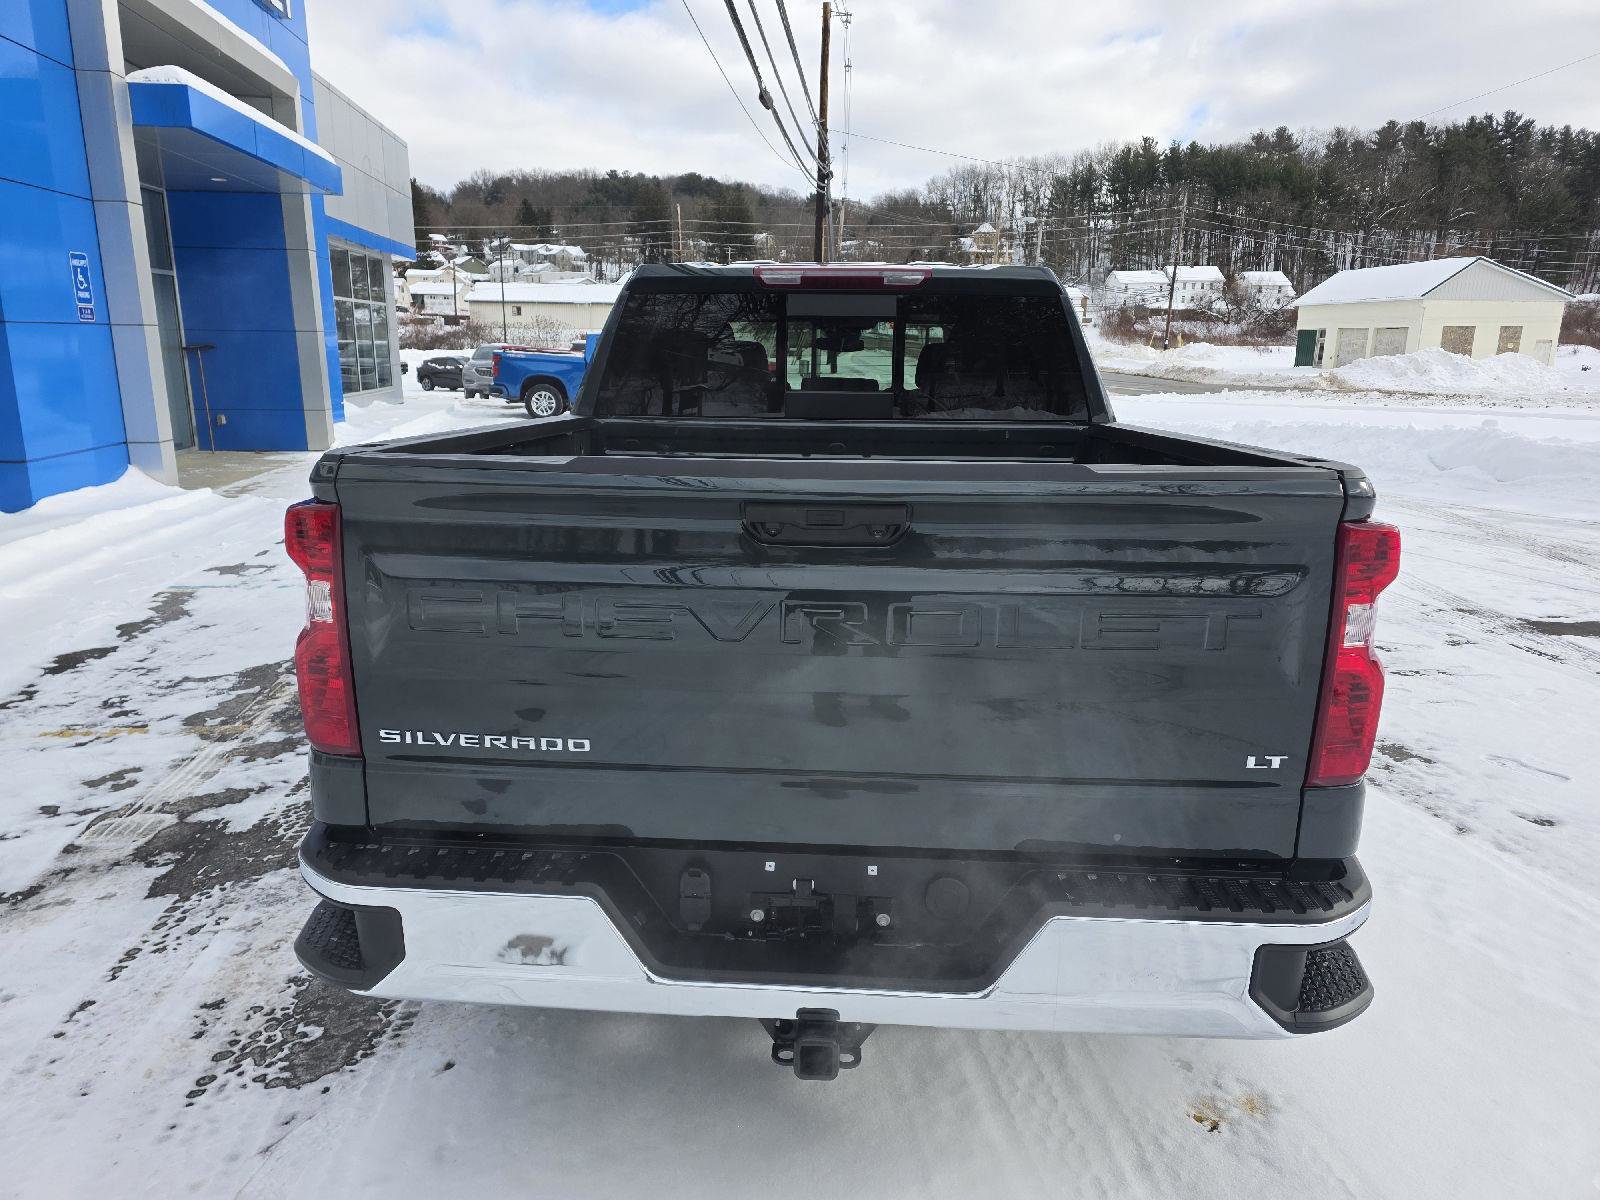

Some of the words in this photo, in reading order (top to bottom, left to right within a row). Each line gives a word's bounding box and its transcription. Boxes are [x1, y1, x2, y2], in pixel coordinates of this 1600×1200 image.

[407, 590, 1262, 651] CHEVROLET
[378, 728, 592, 755] SILVERADO
[1245, 755, 1289, 769] LT
